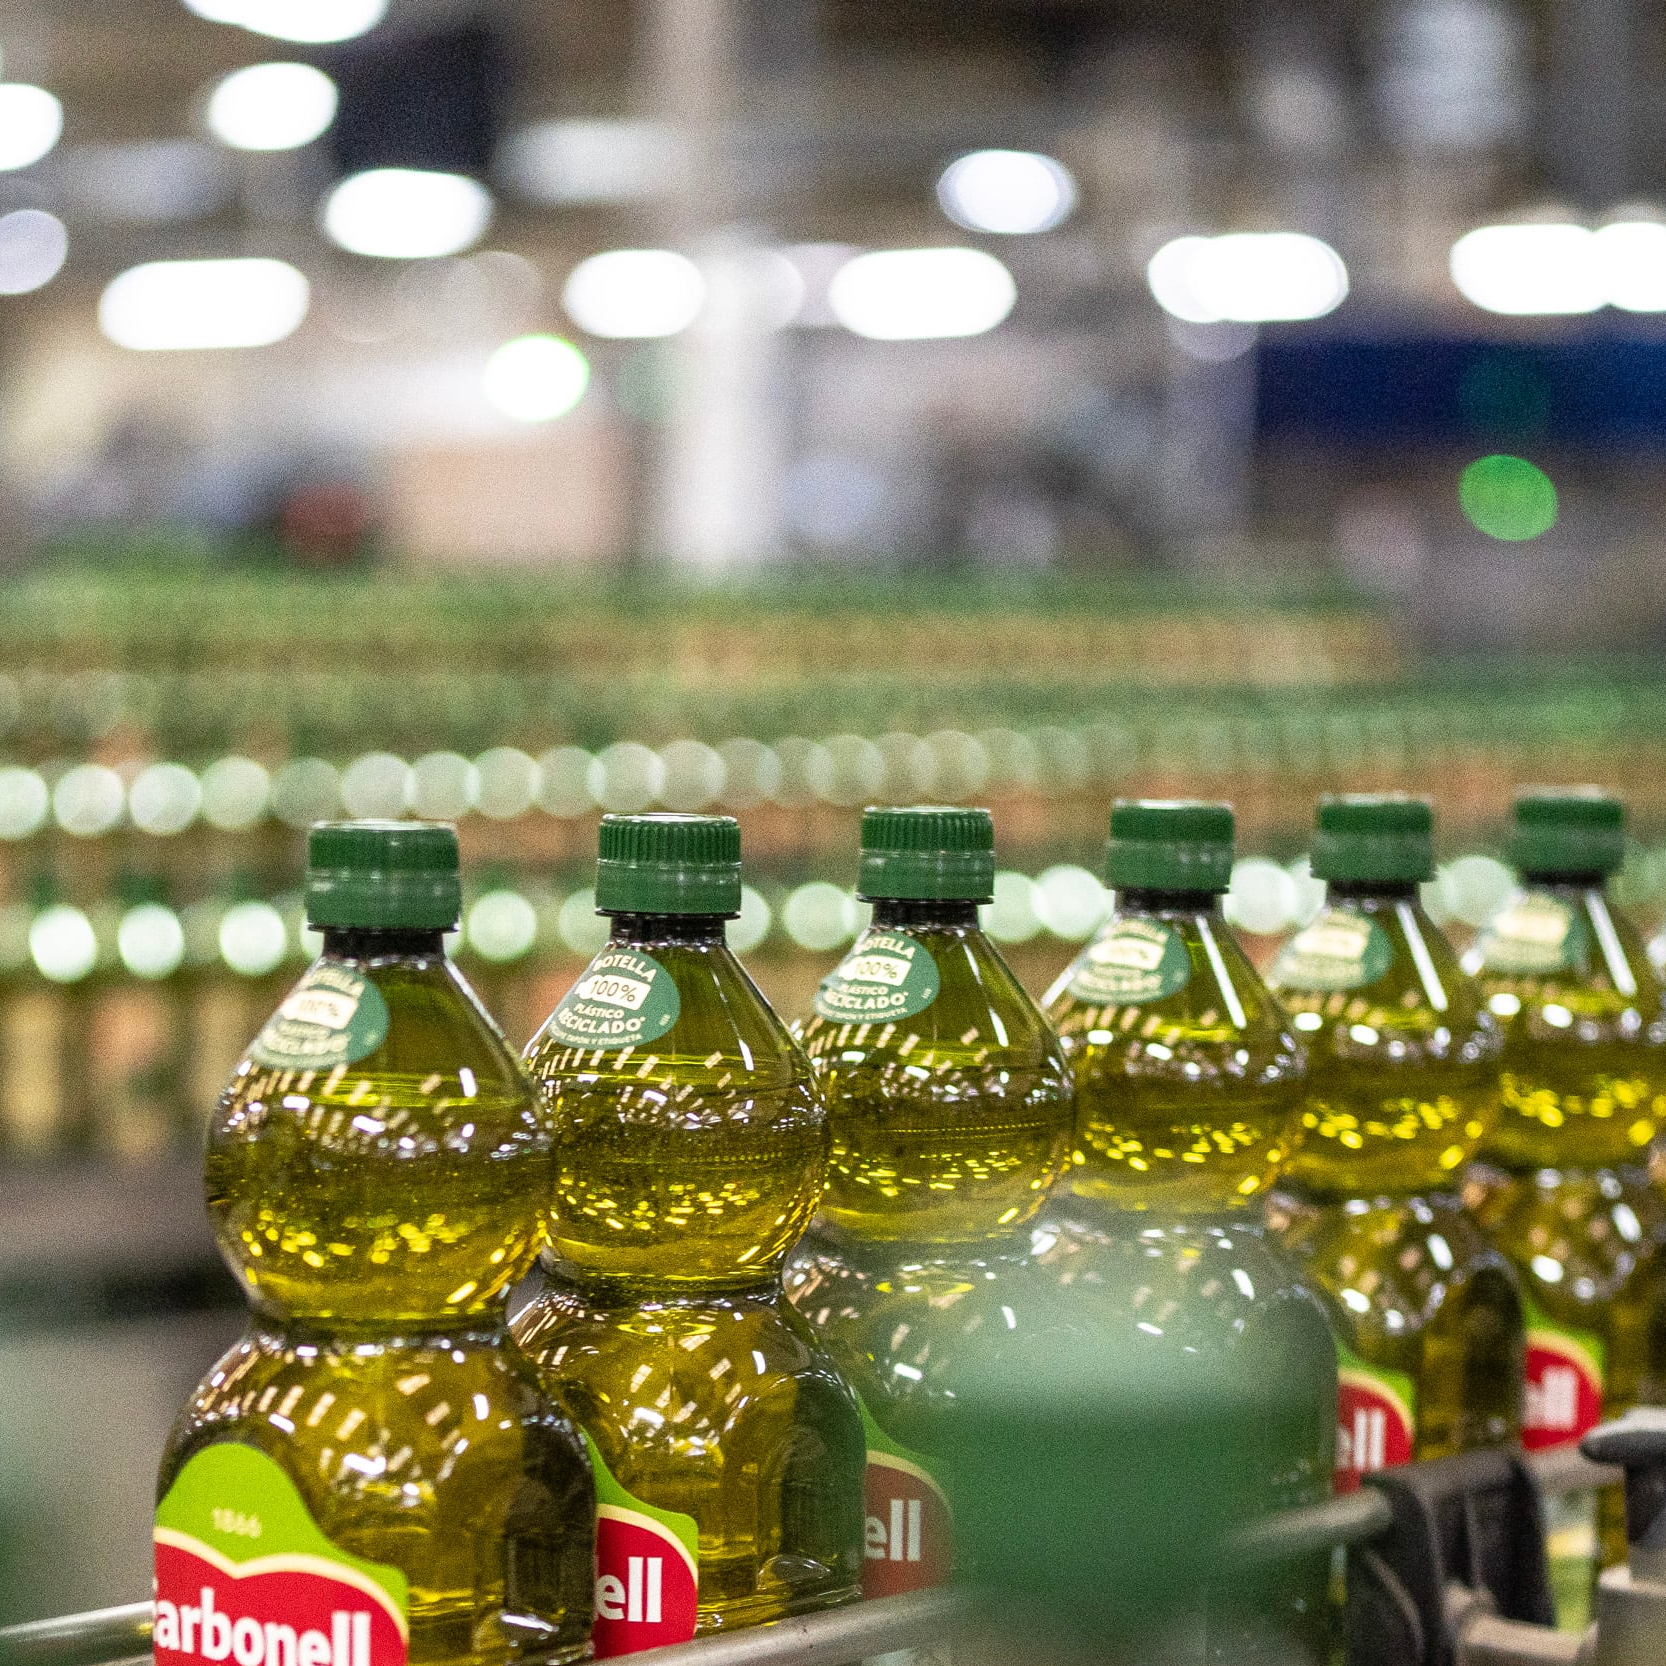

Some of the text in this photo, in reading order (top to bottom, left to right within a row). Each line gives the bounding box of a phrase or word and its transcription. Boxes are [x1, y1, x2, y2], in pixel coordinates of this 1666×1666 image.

[590, 980, 638, 1002] 100%
[856, 961, 898, 979] 100%
[865, 1499, 921, 1562] ell
[596, 1556, 663, 1623] ell
